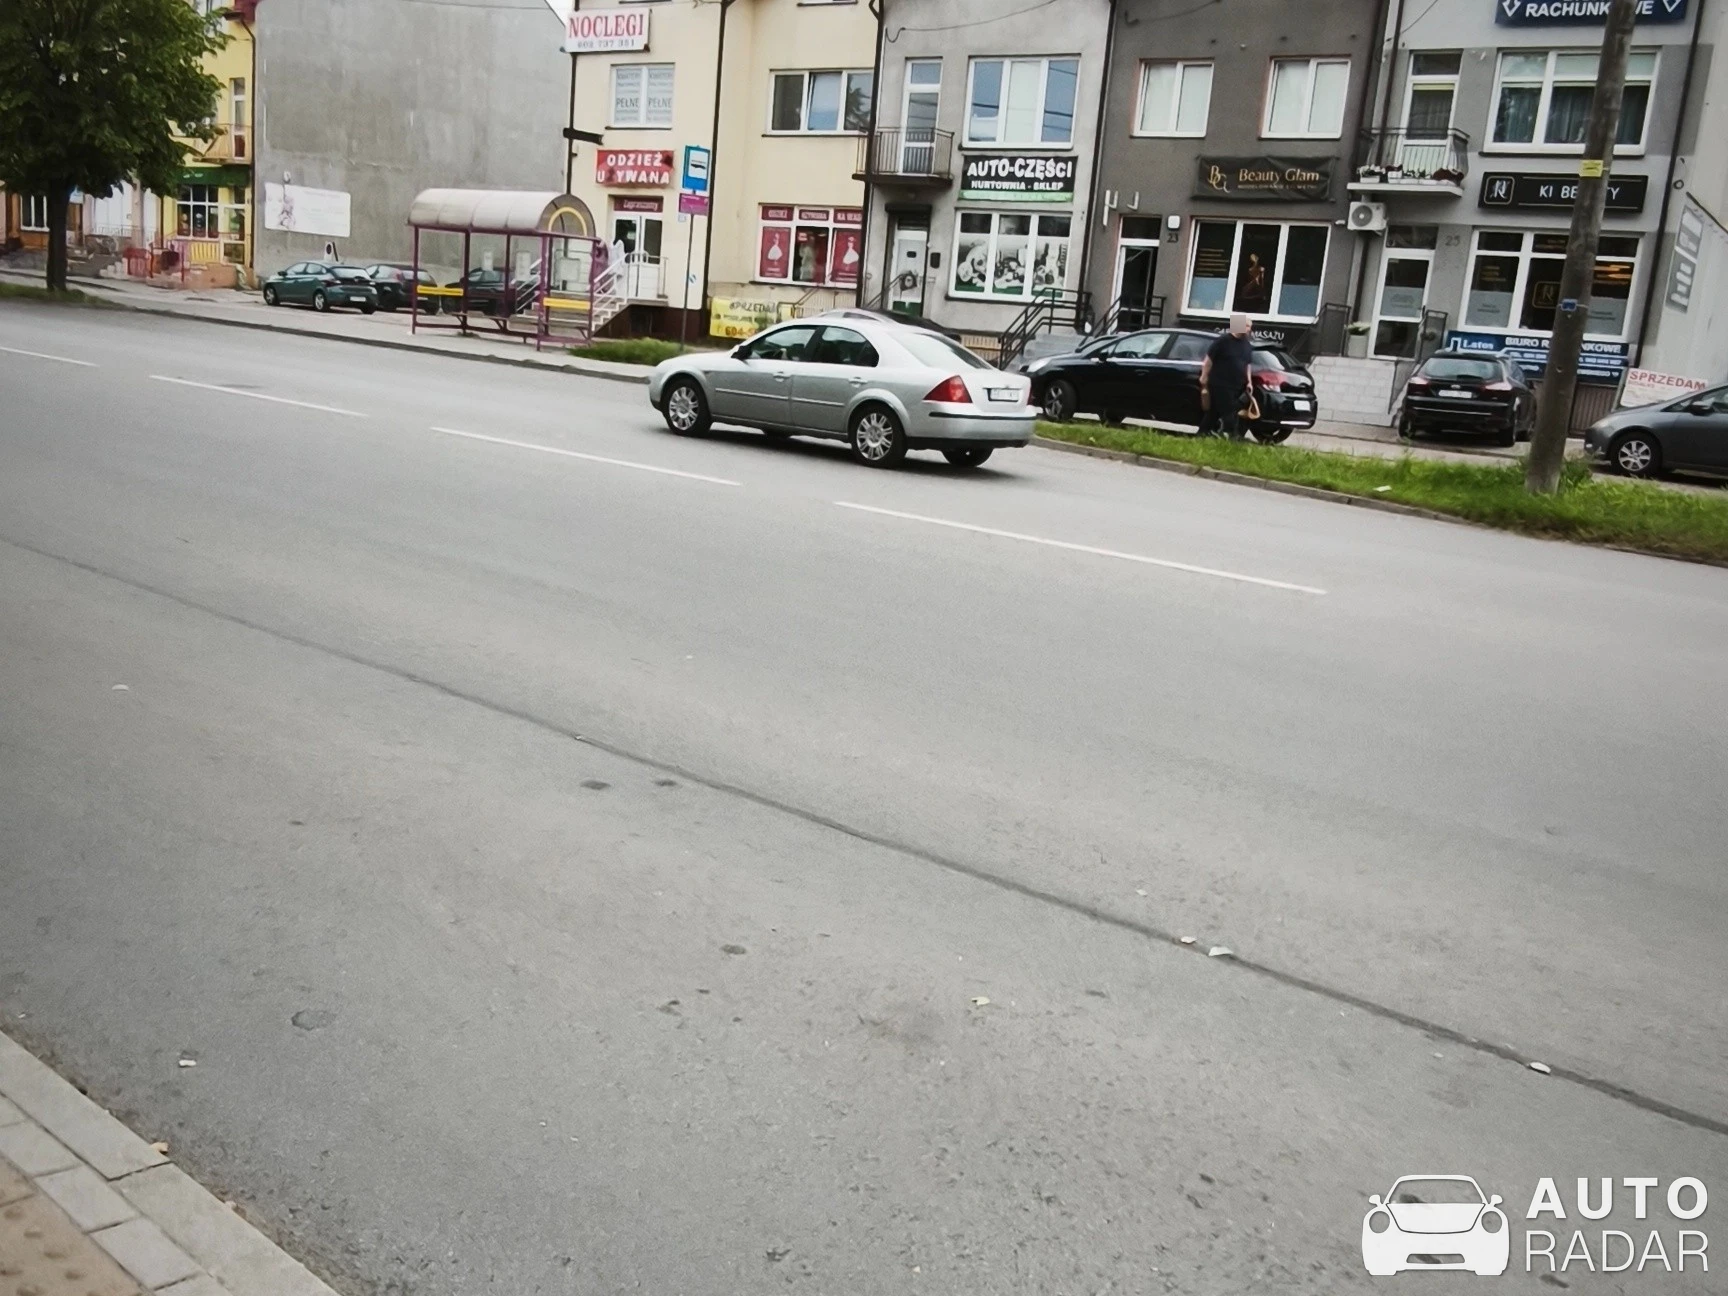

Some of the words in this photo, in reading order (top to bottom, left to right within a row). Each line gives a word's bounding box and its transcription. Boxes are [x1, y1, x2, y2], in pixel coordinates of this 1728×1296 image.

[1525, 3, 1653, 17] RACHUNKE
[569, 14, 644, 38] NOCLEGI
[606, 152, 663, 167] ODZIEŻ
[967, 158, 1073, 180] AUTO-CZĘŚCI
[1239, 168, 1280, 186] Beauty
[1285, 168, 1320, 181] Glam
[1033, 182, 1064, 191] SKLEP
[1539, 185, 1553, 198] KI
[1505, 337, 1539, 347] BIURO
[1629, 370, 1707, 391] SPRZEDAM
